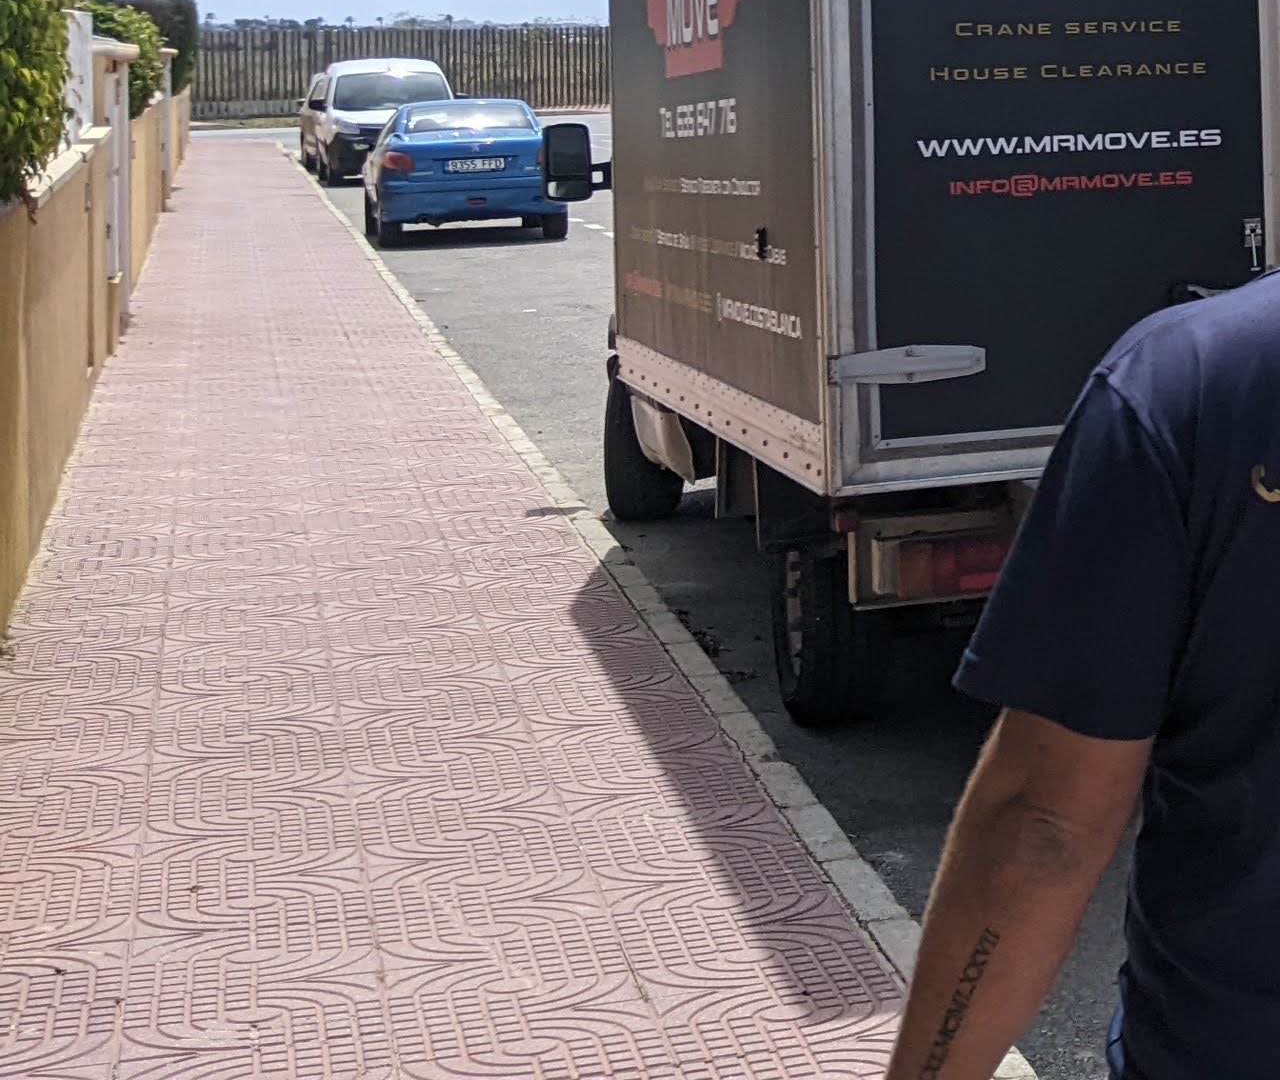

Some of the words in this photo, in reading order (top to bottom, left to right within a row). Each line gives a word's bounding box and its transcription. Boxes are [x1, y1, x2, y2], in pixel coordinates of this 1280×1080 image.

[955, 22, 1052, 37] CRANE
[1065, 20, 1181, 34] SERVICE
[930, 66, 1028, 82] HOUSE
[1041, 62, 1208, 79] CLEARANCE
[918, 129, 1222, 158] WWW.MRMOVE.ES
[950, 171, 1194, 196] INFO@MRMOVE.ES
